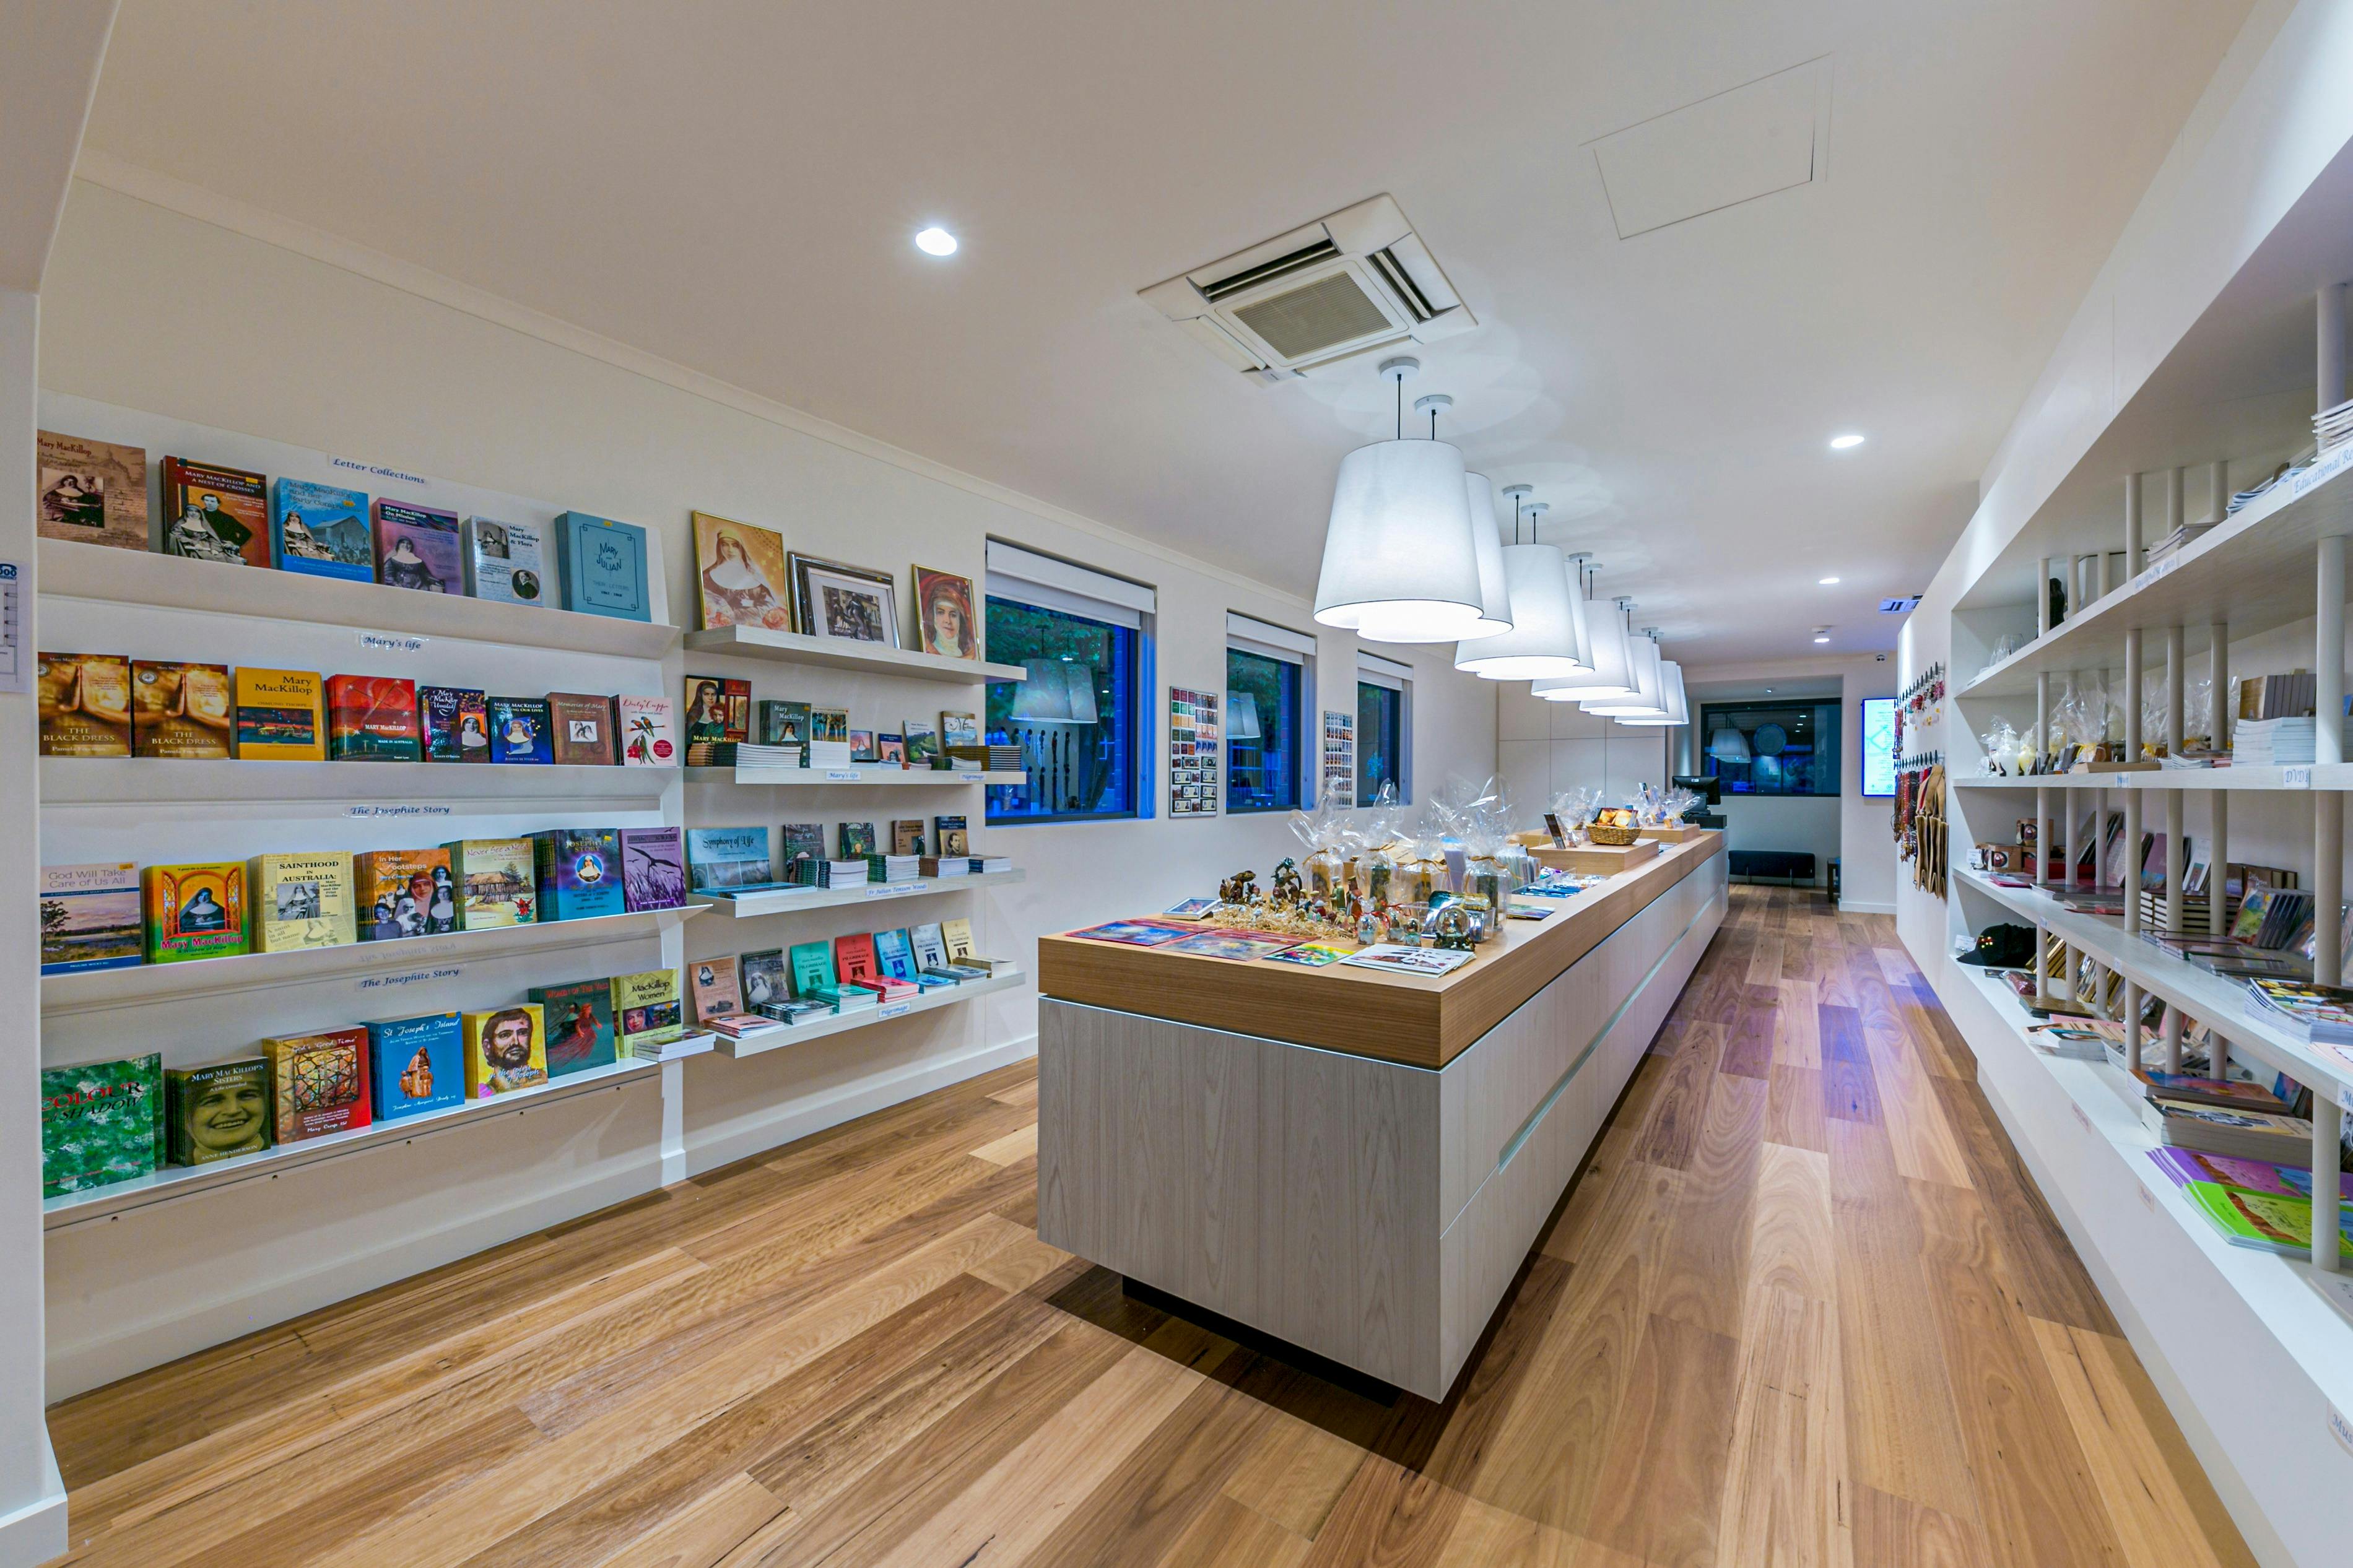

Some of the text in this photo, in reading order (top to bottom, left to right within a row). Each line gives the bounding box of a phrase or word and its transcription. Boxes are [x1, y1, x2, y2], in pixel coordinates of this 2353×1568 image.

[37, 437, 92, 456] Mary MacKillop
[333, 458, 425, 484] Letter Collections
[2294, 451, 2341, 493] Educational
[227, 485, 254, 493] CROSSES
[396, 513, 415, 521] Mission
[401, 508, 427, 518] MacKillop
[510, 532, 539, 543] MacKillop
[599, 543, 619, 558] MARY
[596, 557, 622, 571] JULIAN
[364, 636, 421, 650] Mary's life
[283, 676, 311, 685] Mary
[255, 683, 312, 695] MacKillop
[584, 702, 590, 710] of
[591, 703, 606, 711] Mary
[779, 713, 804, 722] MacKillop
[350, 805, 450, 816] The Josephite Story
[703, 836, 754, 849] Symphony of Life
[467, 849, 488, 857] Never
[511, 842, 530, 851] Need
[279, 861, 339, 870] SAINTHOOD
[380, 862, 427, 871] Footsteps
[49, 872, 72, 880] God
[101, 869, 126, 877] Take
[50, 880, 76, 888] Care
[274, 924, 290, 932] saint
[160, 935, 243, 950] Mary MacKillop
[362, 968, 459, 988] The Josephite Story
[632, 979, 670, 993] MacKillop
[638, 991, 665, 1001] Women
[383, 1028, 393, 1038] St
[398, 1023, 429, 1036] Joseph's
[435, 1018, 461, 1029] Island
[499, 1065, 532, 1077] the spirit
[191, 1072, 214, 1082] MARY
[214, 1075, 243, 1085] SISTERS
[41, 1081, 144, 1112] COLOUR
[60, 1096, 144, 1121] SHADOW
[219, 1145, 258, 1156] HENDERSON
